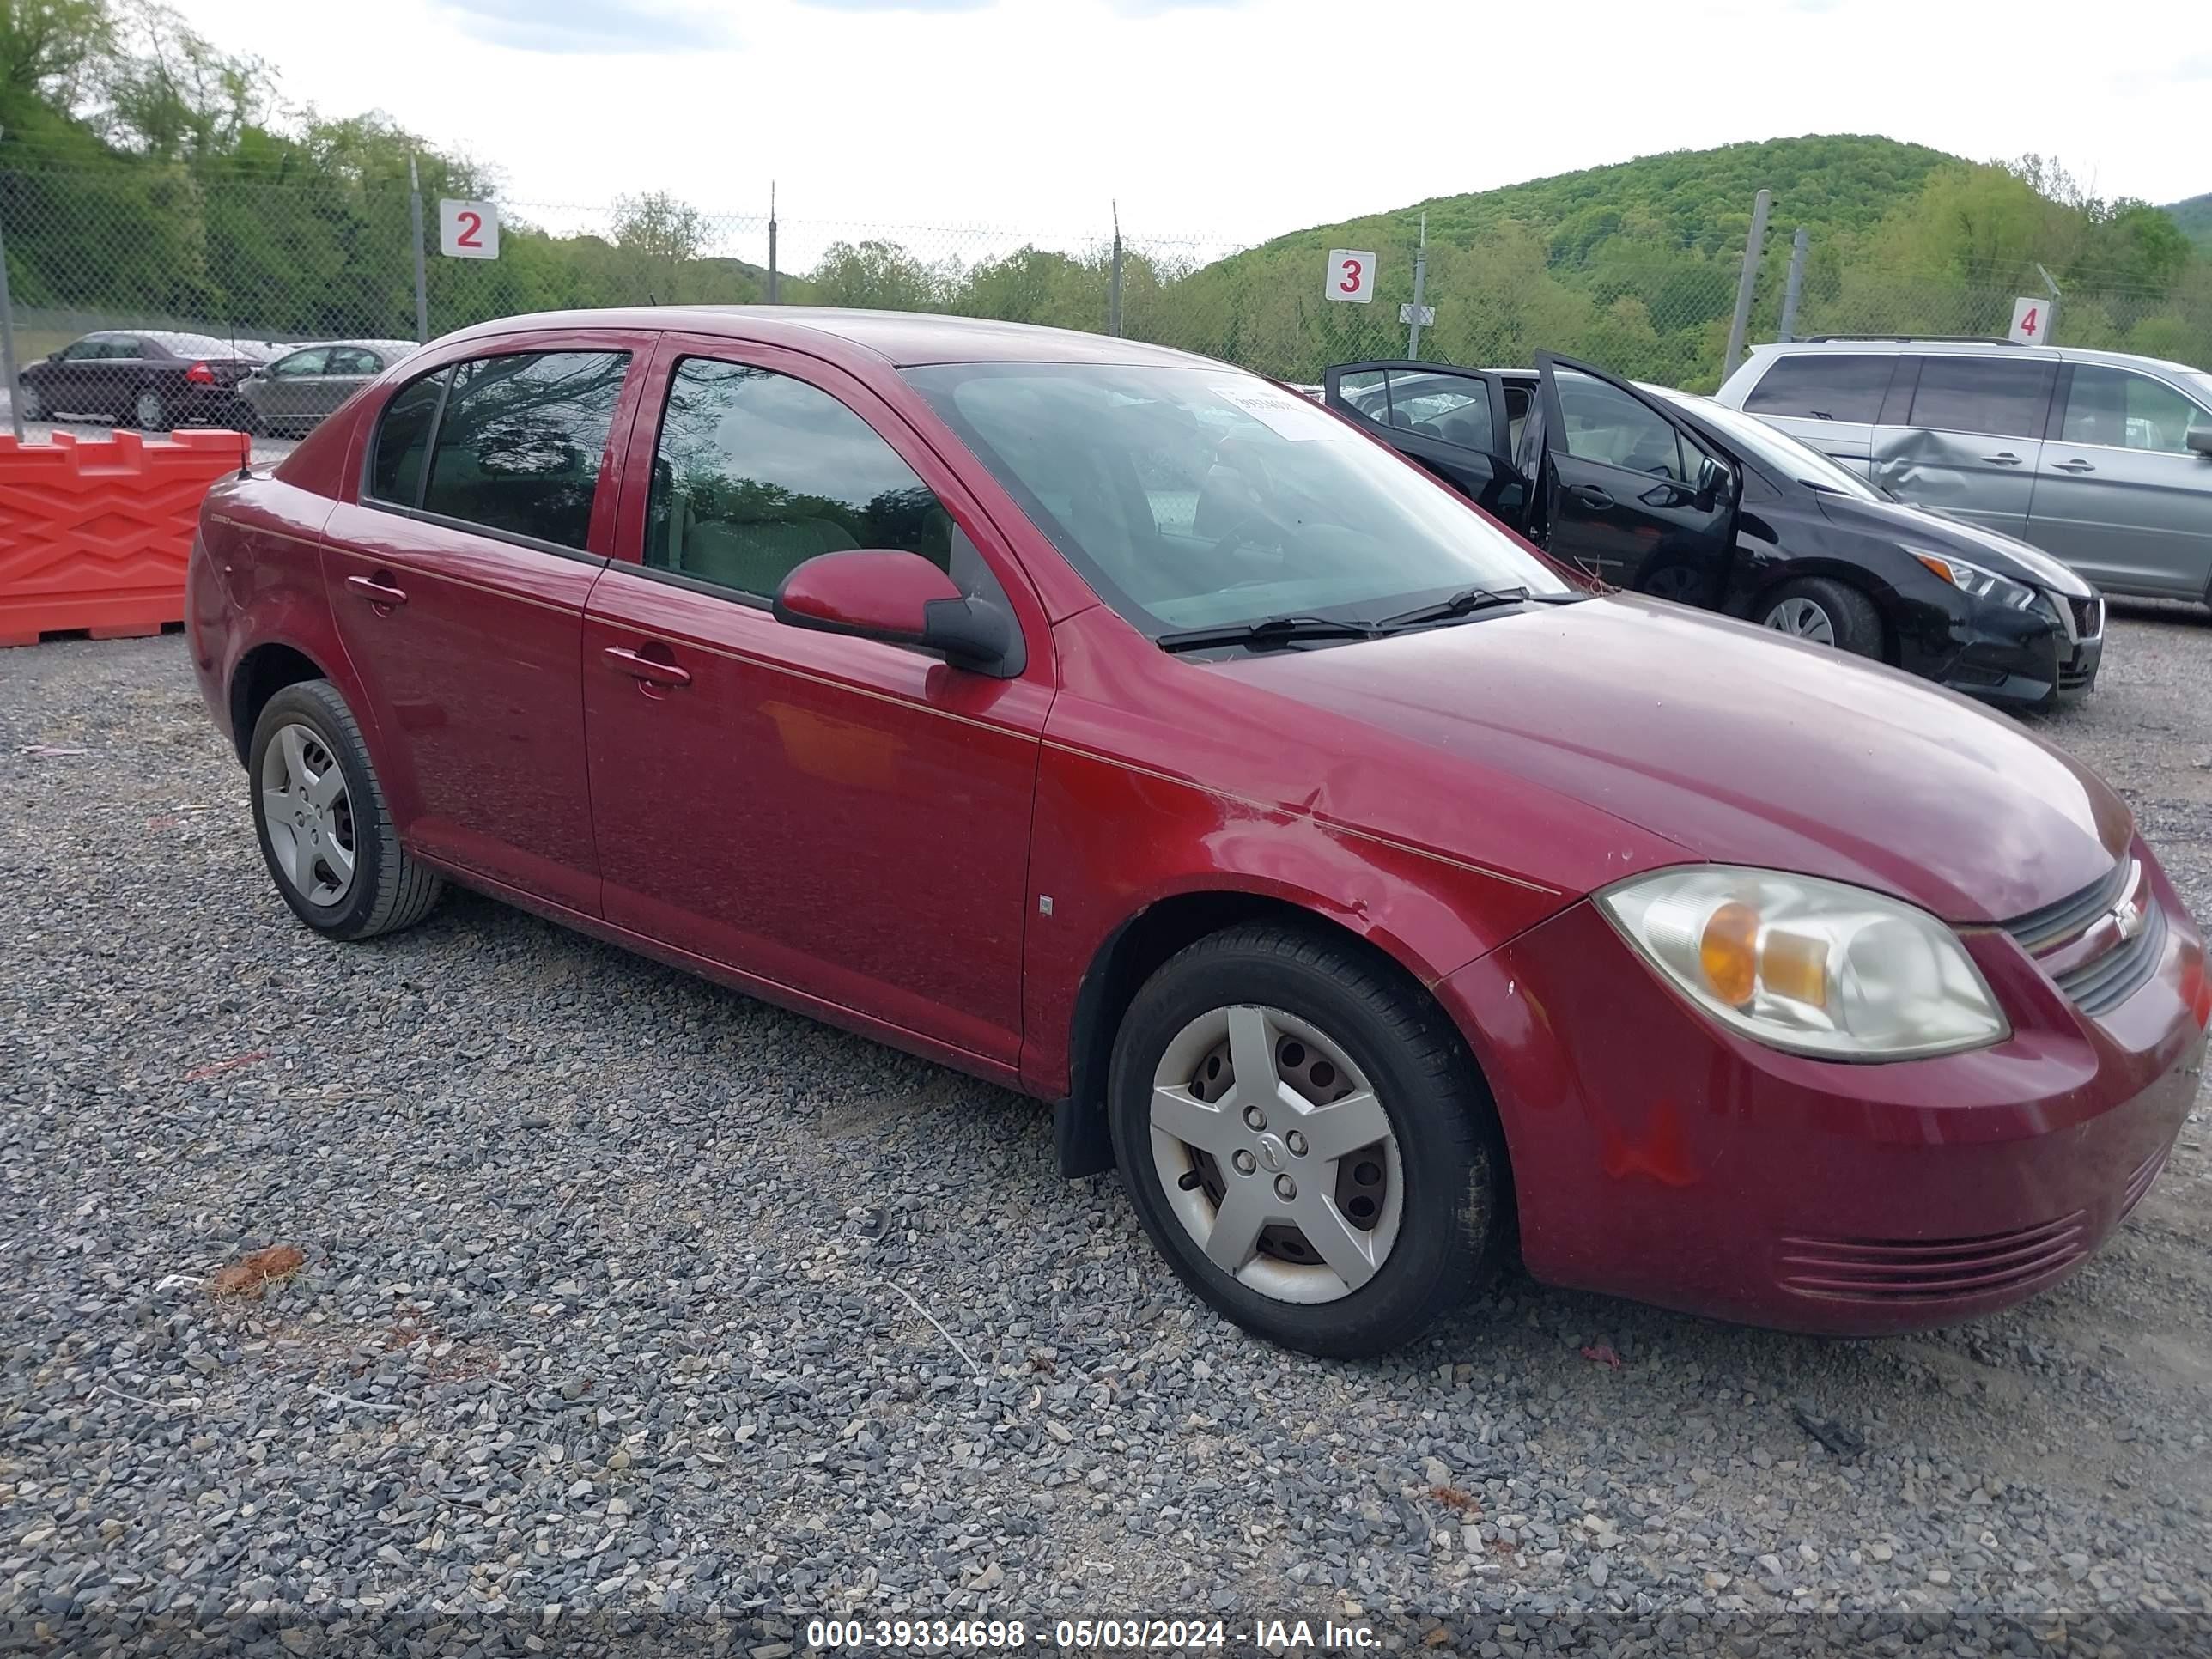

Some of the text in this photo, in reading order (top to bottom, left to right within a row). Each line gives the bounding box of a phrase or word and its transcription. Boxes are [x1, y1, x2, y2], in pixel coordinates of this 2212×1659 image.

[457, 211, 483, 248] 2
[1340, 259, 1362, 293] 3
[2020, 307, 2038, 337] 4
